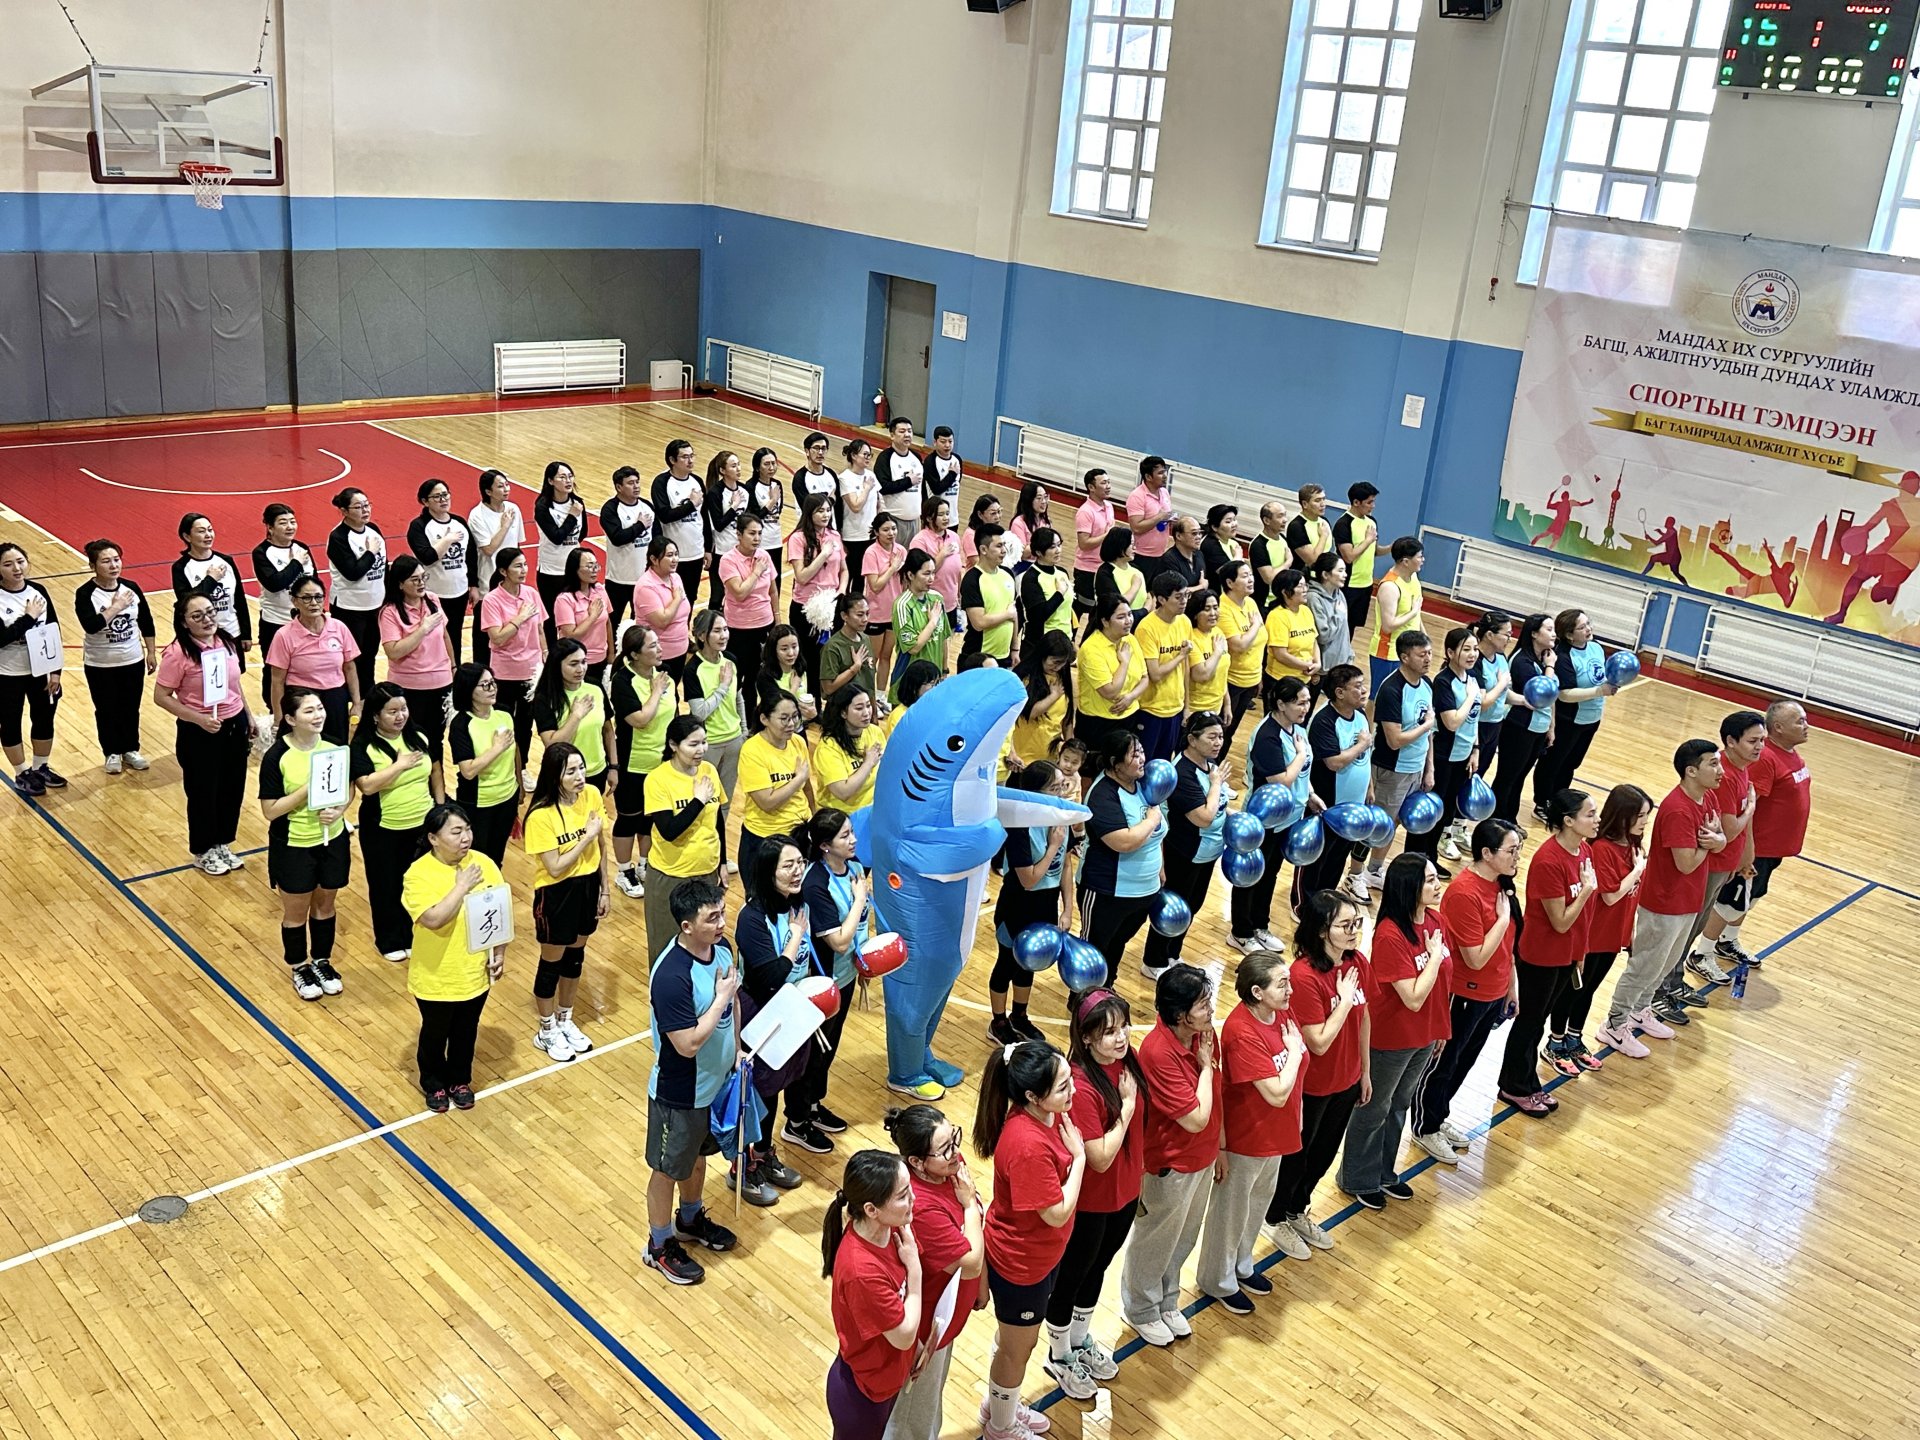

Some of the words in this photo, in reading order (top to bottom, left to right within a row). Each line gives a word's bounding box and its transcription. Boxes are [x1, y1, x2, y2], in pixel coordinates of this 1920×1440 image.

[1583, 335, 1629, 356] БАГШ,
[1632, 344, 1759, 378] АЖИЛТНУУДЫН
[1761, 367, 1836, 392] ДУНДАХ
[1839, 379, 1920, 407] УЛАМЖЛ
[1656, 329, 1730, 353] МАНДАХ
[1731, 341, 1757, 358] ИХ
[1760, 346, 1876, 378] СУРГУУЛИЙН
[1629, 383, 1748, 422] СПОРТЫН
[1753, 406, 1878, 447] ТЭМЦЭЭН
[1644, 417, 1668, 430] БАГ
[1669, 420, 1743, 446] ТАМИРЧДАД
[1743, 437, 1801, 458] АМЖИЛТ
[1800, 449, 1846, 468] ХҮСЬЕ
[556, 827, 587, 846] Шарк
[1734, 884, 1744, 902] 1
